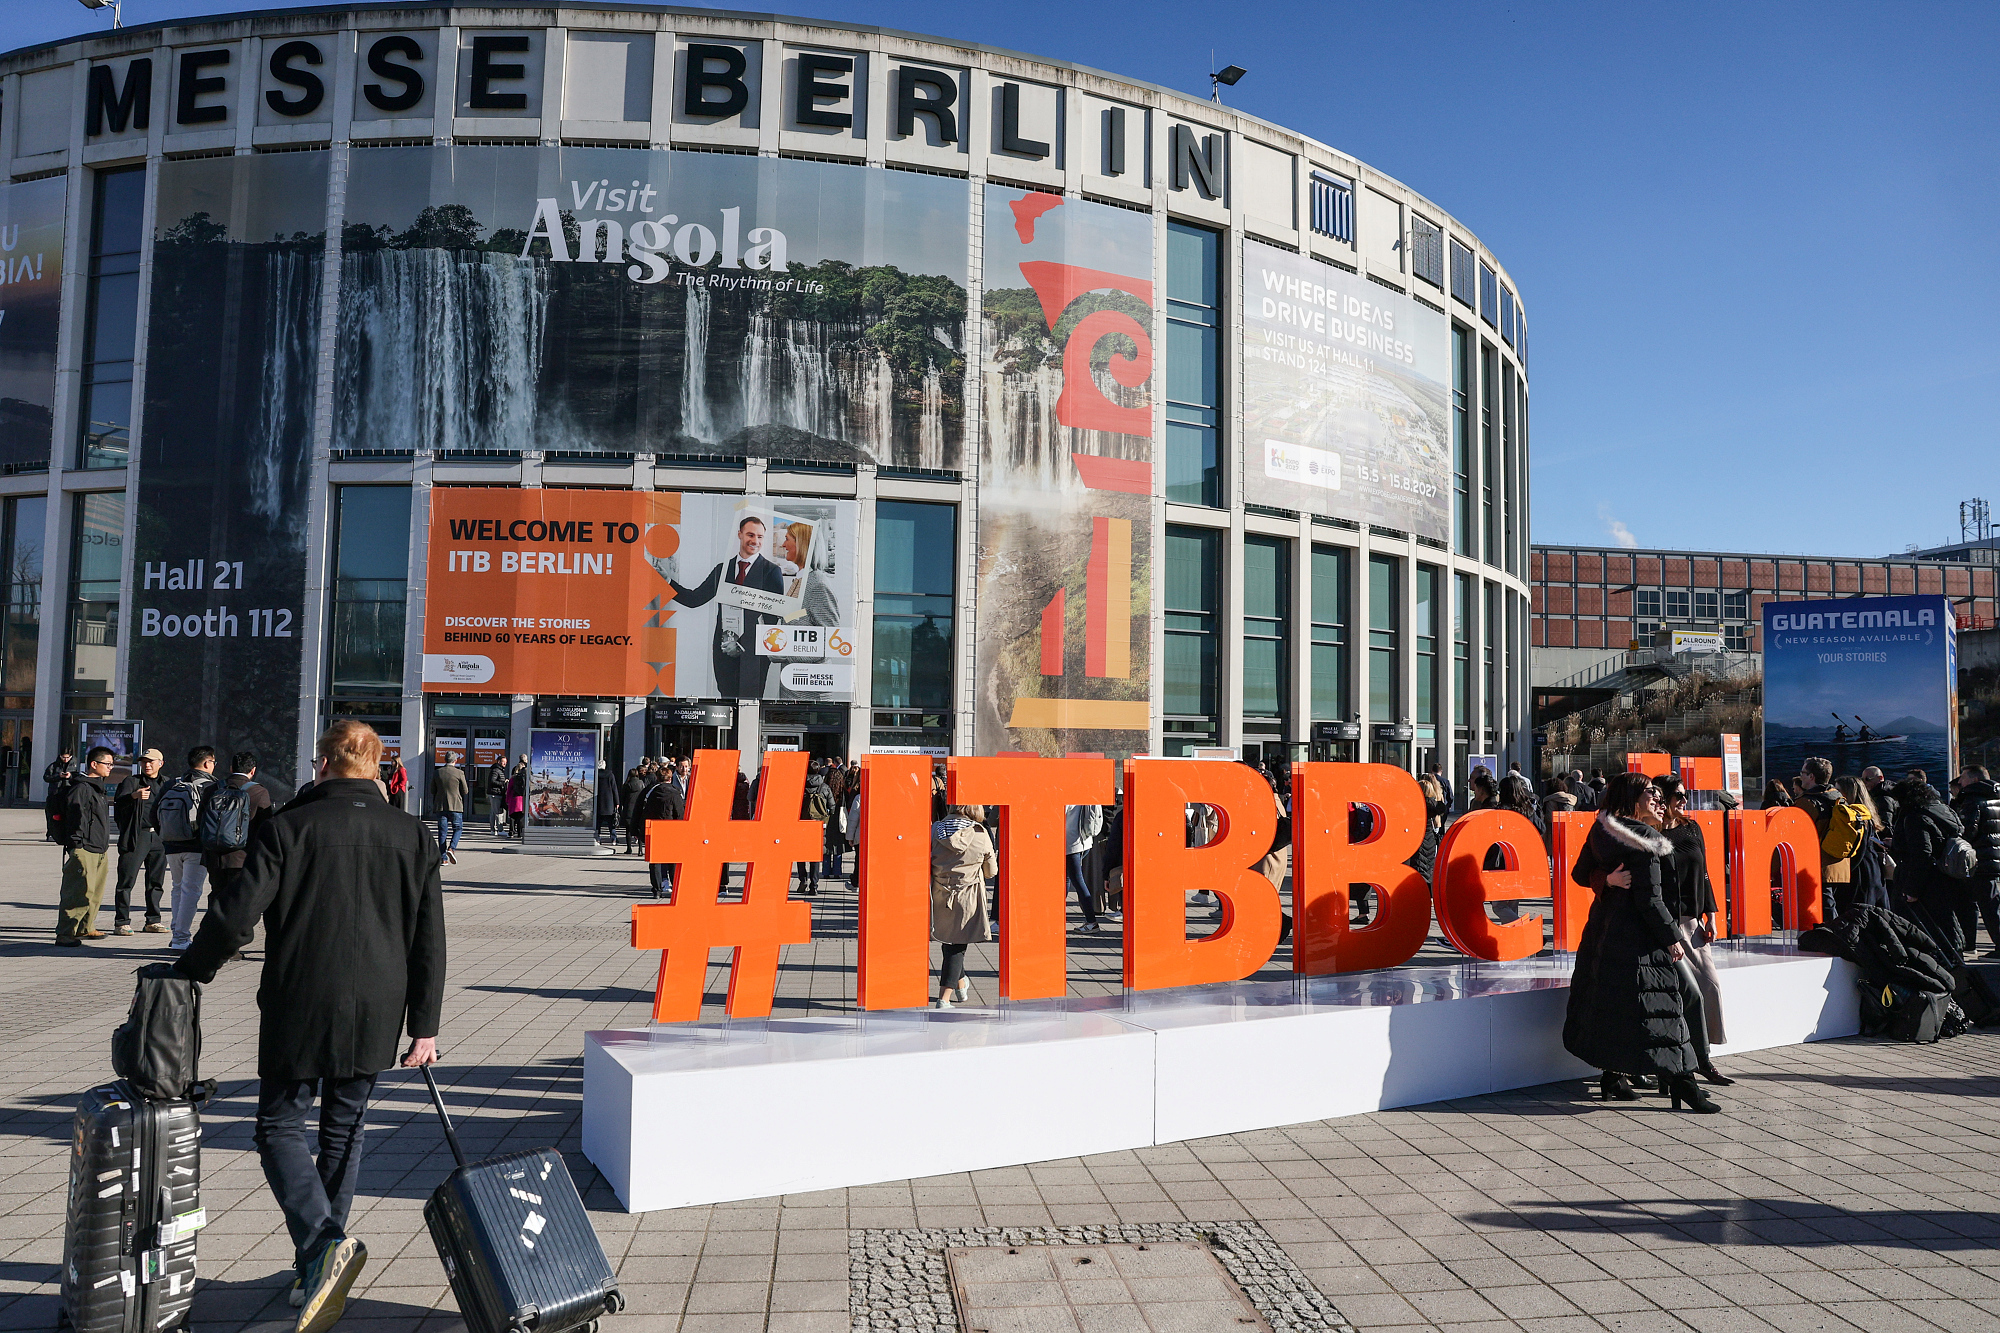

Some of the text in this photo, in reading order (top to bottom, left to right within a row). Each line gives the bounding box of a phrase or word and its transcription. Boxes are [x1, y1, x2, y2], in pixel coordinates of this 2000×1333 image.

[87, 36, 1222, 198] MESSE BERLIN
[571, 178, 657, 213] Visit
[516, 197, 790, 284] Angola
[675, 272, 824, 294] The Rhythm of Life
[1261, 268, 1394, 331] WHERE IDEAS
[1262, 297, 1414, 364] DRIVE BUSINESS
[1262, 328, 1374, 373] VISIT US AT HALL 1.1
[1263, 346, 1327, 376] STAND 124
[1321, 467, 1336, 476] EXPO
[1357, 464, 1379, 483] 15.5
[1389, 473, 1437, 498] 15.8.2027
[449, 519, 639, 543] WELCOME TO
[448, 550, 613, 575] ITB BERLIN!
[143, 558, 244, 590] Hall 21
[730, 586, 786, 605] Creating moments
[739, 598, 773, 611] since 1966
[141, 605, 293, 638] Booth 112
[445, 616, 591, 629] DISCOVER THE STORIES
[1772, 608, 1935, 631] GUATEMALA
[444, 632, 633, 646] BEHIND 60 YEARS OF LEGACY.
[793, 630, 818, 643] ITB
[1682, 637, 1717, 645] ALLROUND
[1785, 633, 1921, 645] NEW SEASON AVAILABLE
[793, 645, 818, 653] BERLIN
[1817, 651, 1887, 664] YOUR STORIES
[809, 673, 834, 681] MESSE
[809, 679, 834, 687] BERLIN
